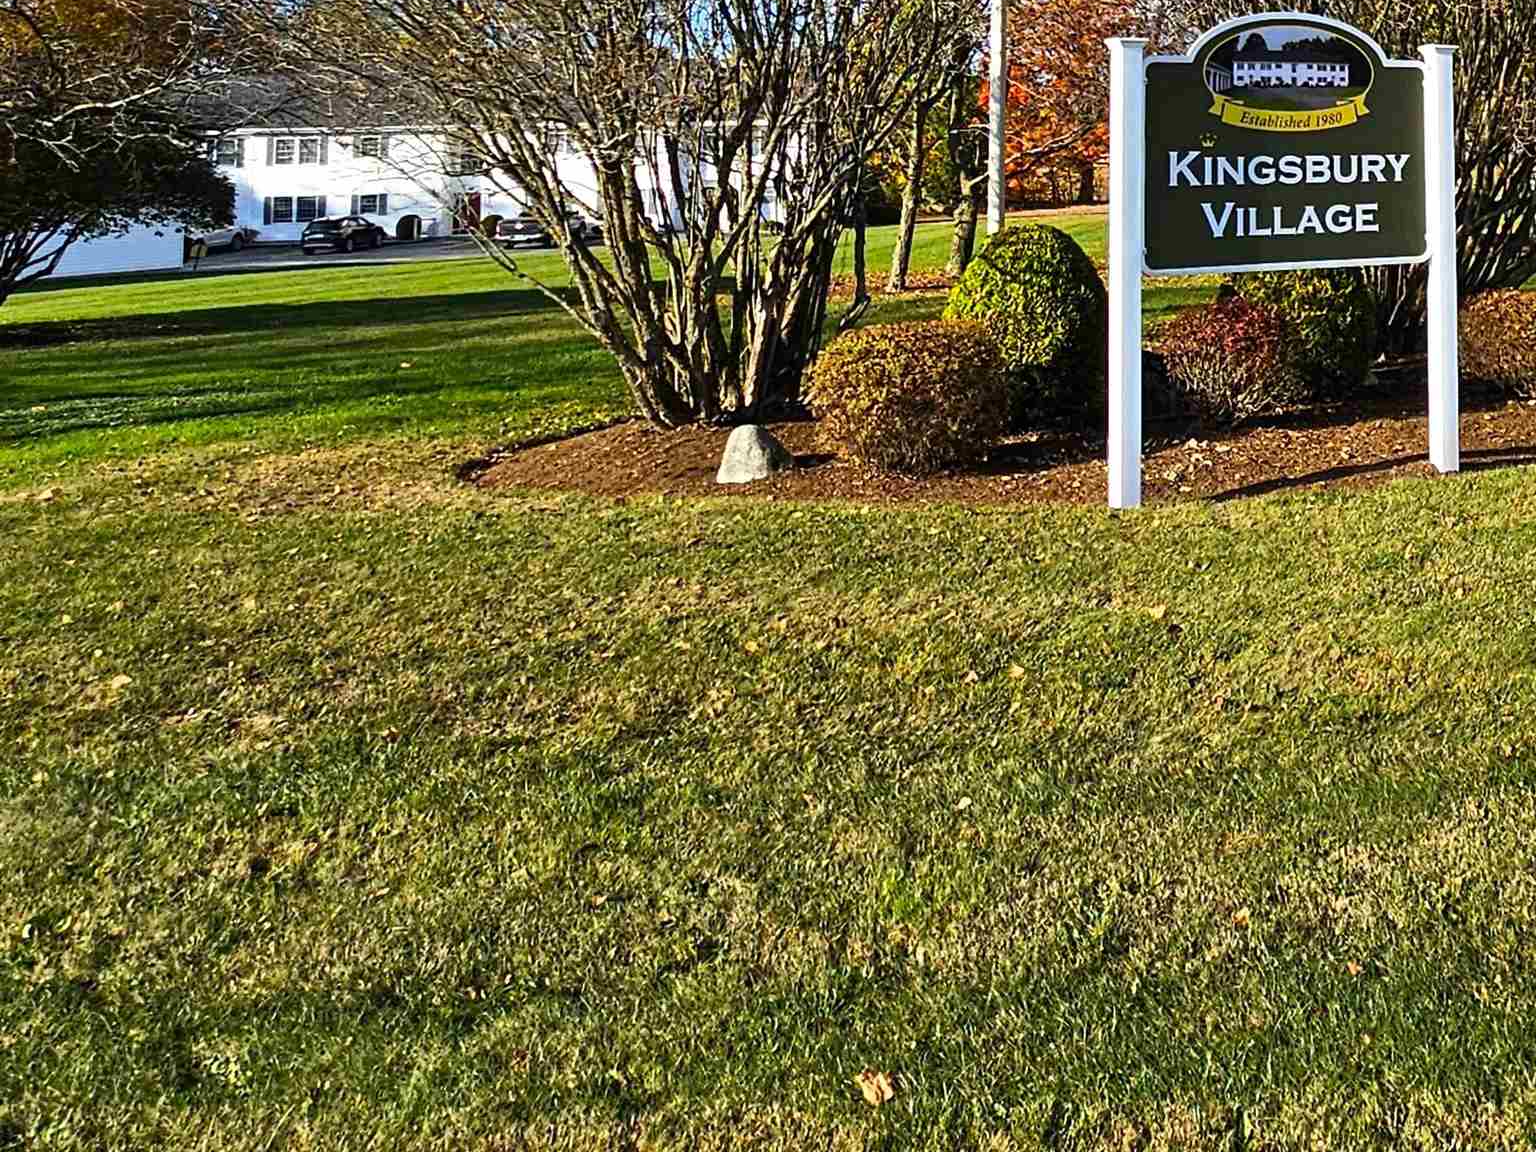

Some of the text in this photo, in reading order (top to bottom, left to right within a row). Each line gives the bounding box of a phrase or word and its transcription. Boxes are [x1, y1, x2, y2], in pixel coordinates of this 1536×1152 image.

[1239, 111, 1343, 129] Established 1980
[1168, 151, 1411, 187] KINGSBURY
[1200, 202, 1380, 238] VILLAGE
